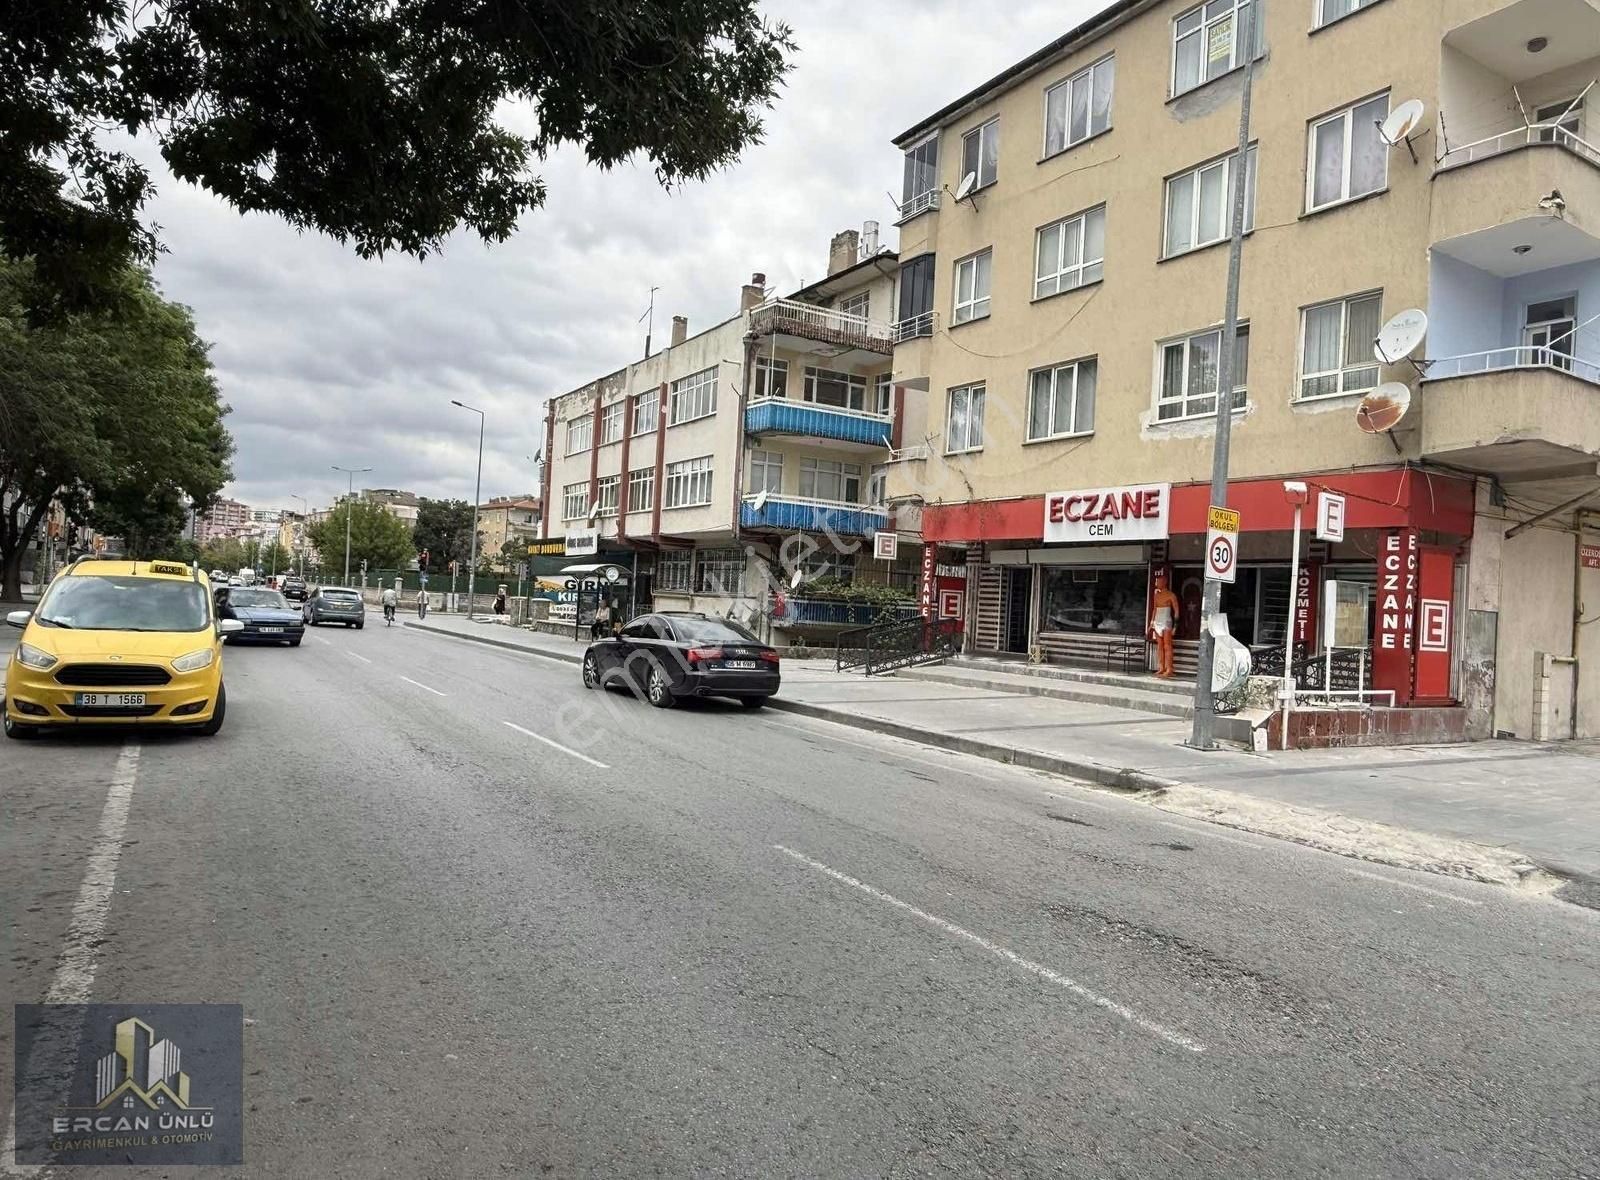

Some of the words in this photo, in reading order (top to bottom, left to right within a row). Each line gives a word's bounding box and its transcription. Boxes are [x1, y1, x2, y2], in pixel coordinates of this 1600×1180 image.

[1049, 489, 1160, 523] ECZANE
[1214, 511, 1233, 522] OKUL
[1088, 524, 1114, 536] CEM
[1214, 546, 1229, 563] 30
[922, 547, 931, 617] ECZANE
[1381, 536, 1401, 649] ECZANE
[1403, 535, 1416, 649] ECZANE
[84, 695, 96, 704] 38
[104, 695, 109, 704] T
[118, 695, 143, 704] 1566
